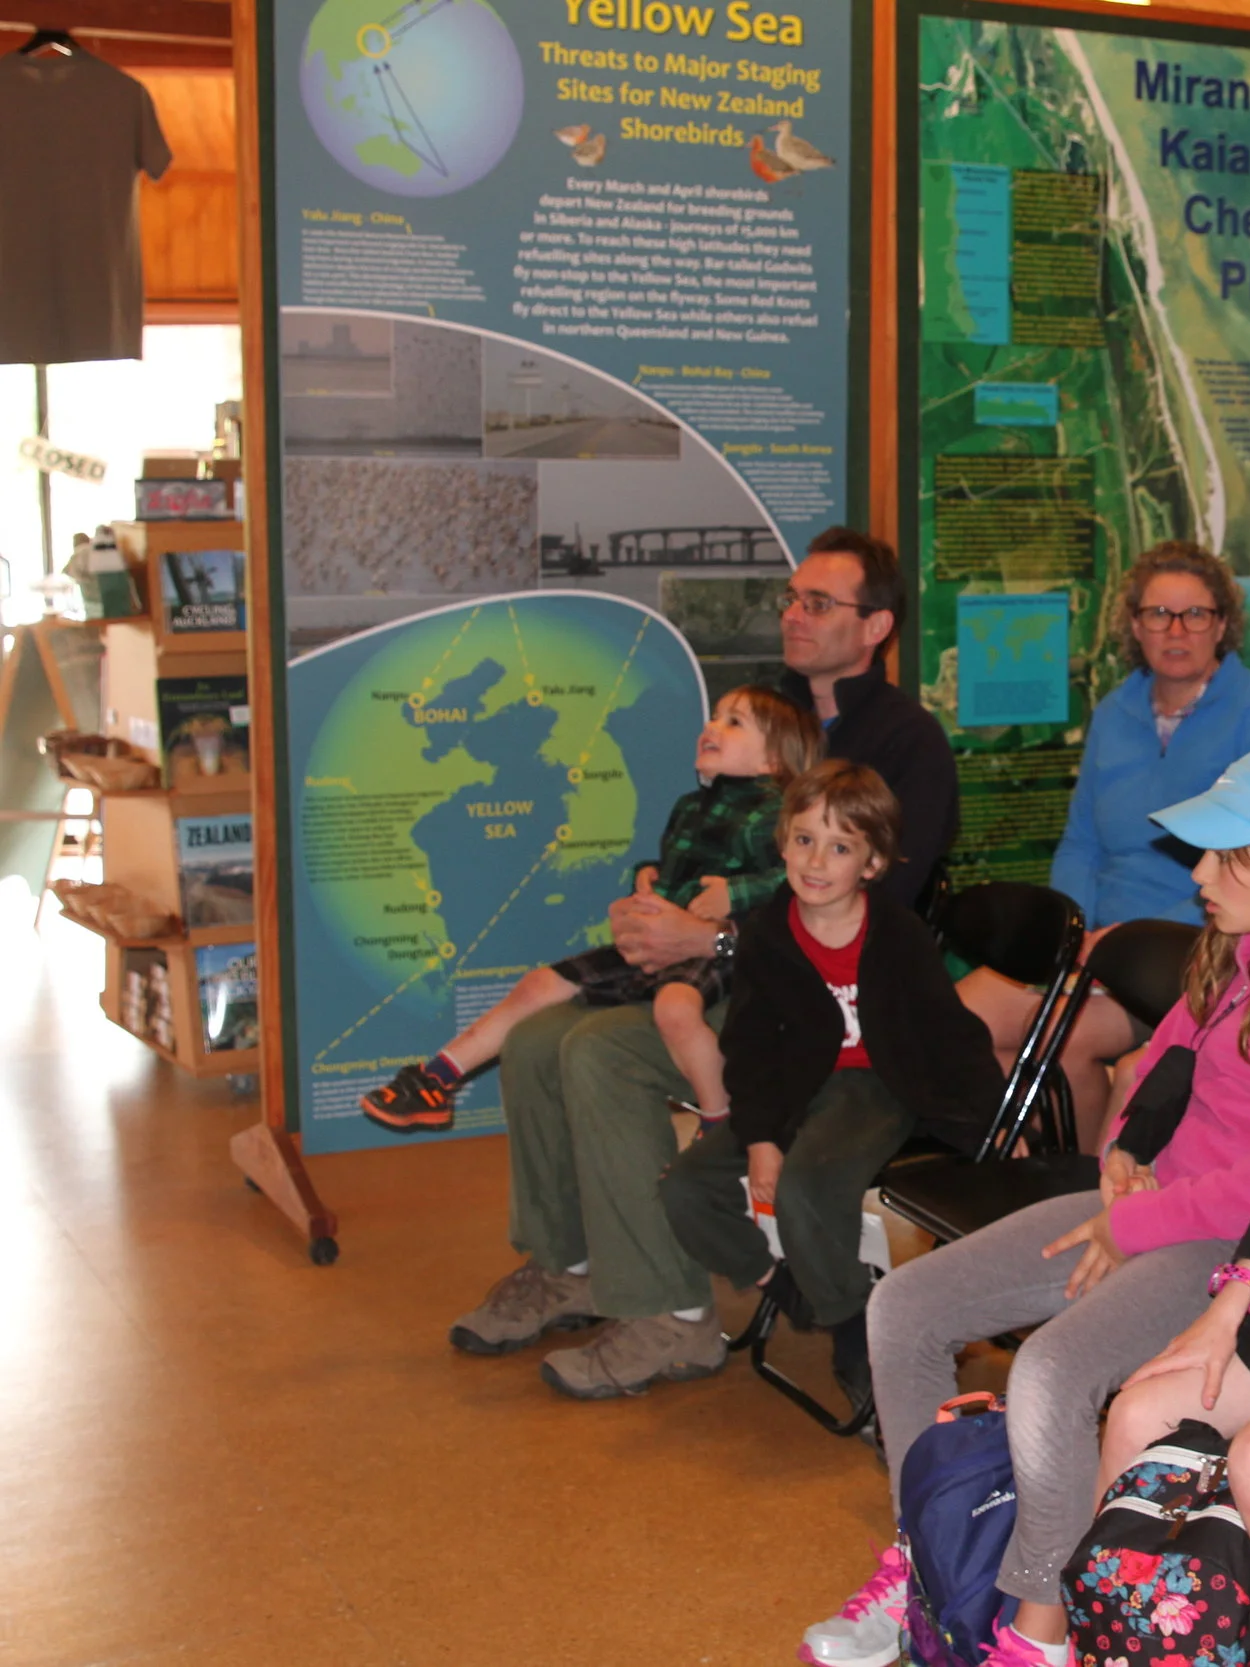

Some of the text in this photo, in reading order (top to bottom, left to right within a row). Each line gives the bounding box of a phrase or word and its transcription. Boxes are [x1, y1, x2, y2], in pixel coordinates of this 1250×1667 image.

[565, 0, 803, 46] Yellow Sea
[539, 42, 821, 93] Threats to Major Staging
[557, 78, 803, 118] Sites for New Zealand
[620, 118, 744, 147] Shorebirds
[413, 708, 467, 725] BOHAI
[467, 801, 534, 817] YELLOW
[484, 824, 516, 839] SEA
